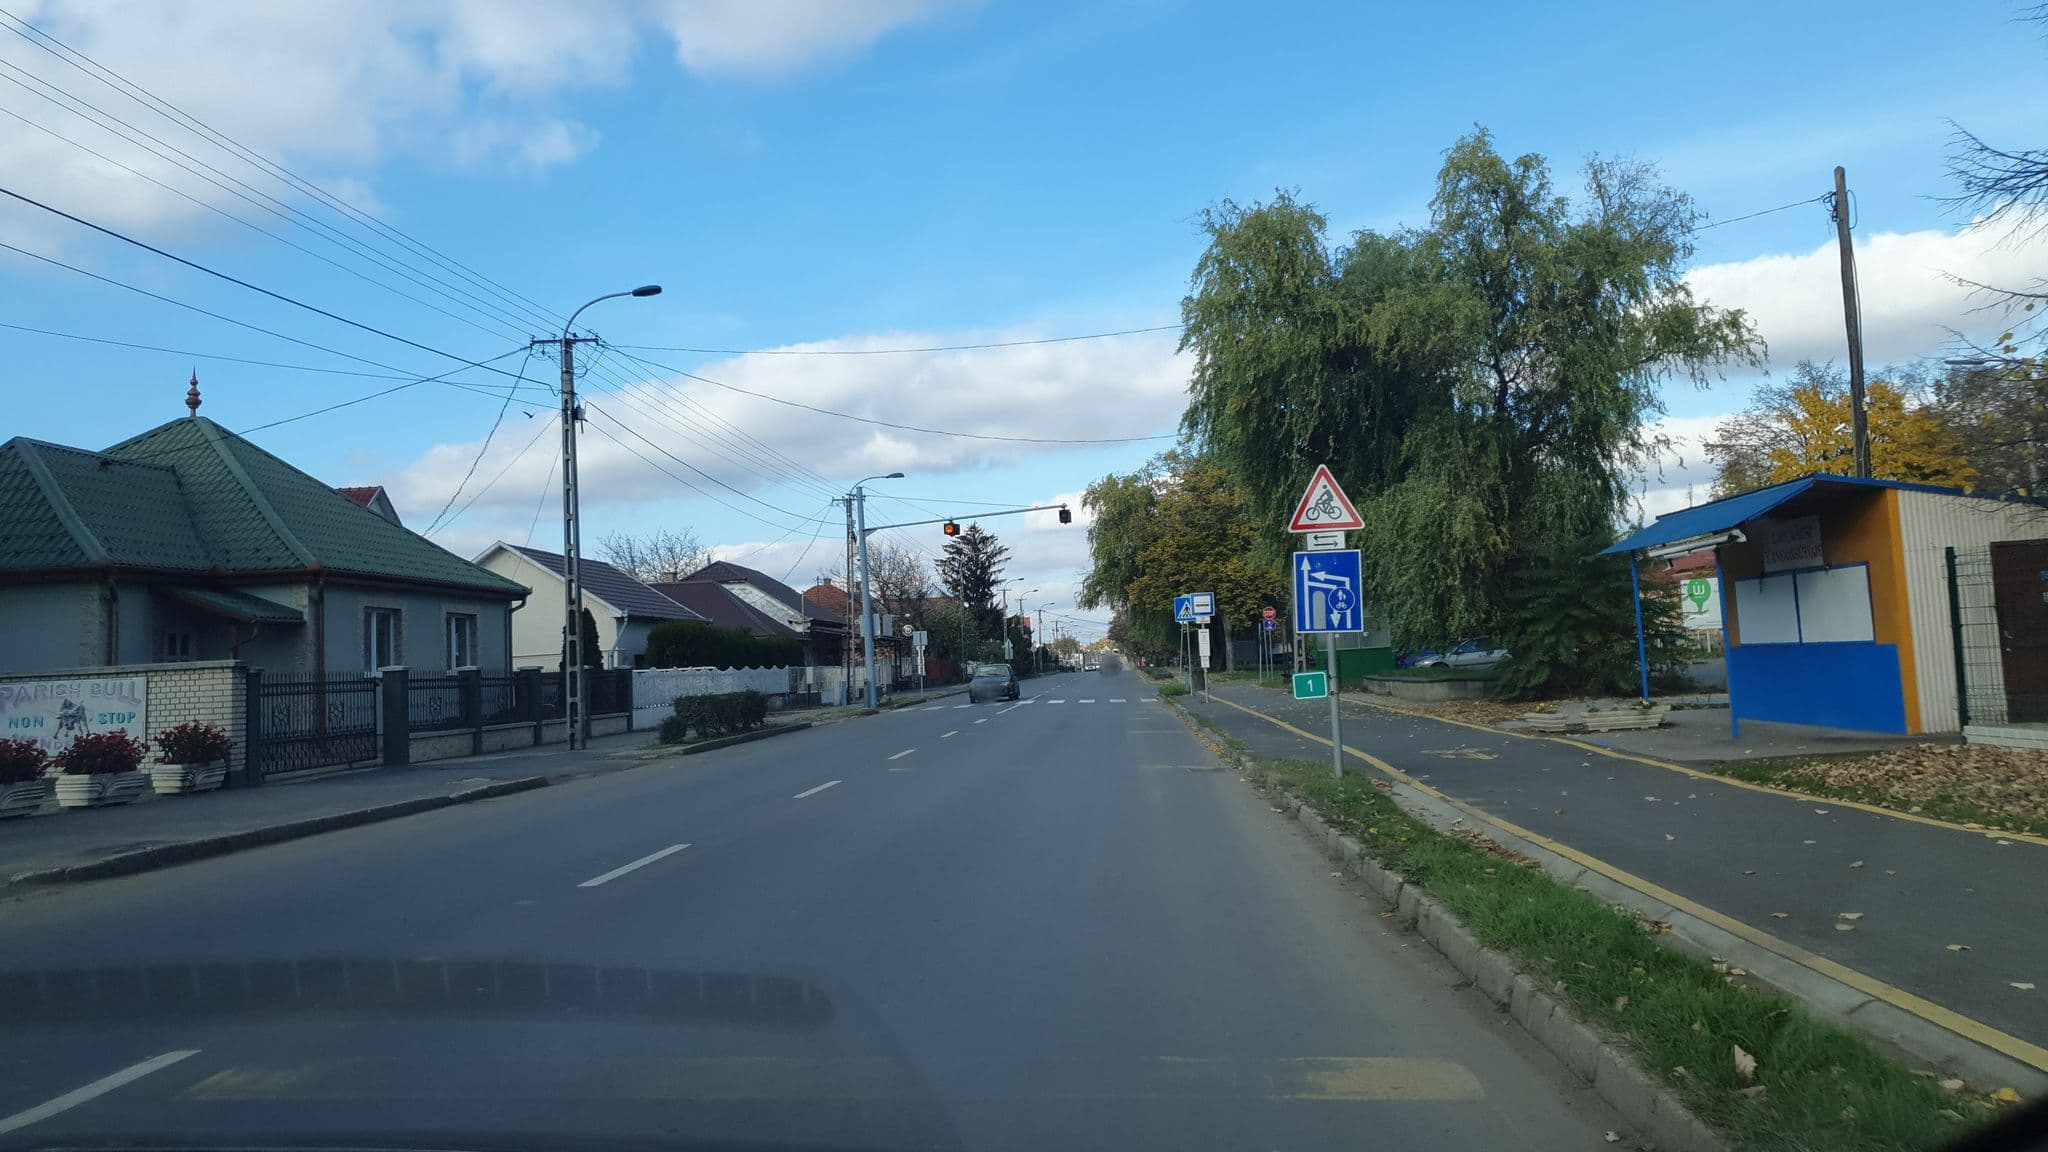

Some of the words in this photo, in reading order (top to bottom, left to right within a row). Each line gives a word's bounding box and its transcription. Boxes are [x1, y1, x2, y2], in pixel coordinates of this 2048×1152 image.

[91, 681, 142, 706] BULL
[1307, 679, 1313, 692] 1
[9, 716, 44, 729] NON
[98, 711, 137, 725] STOP
